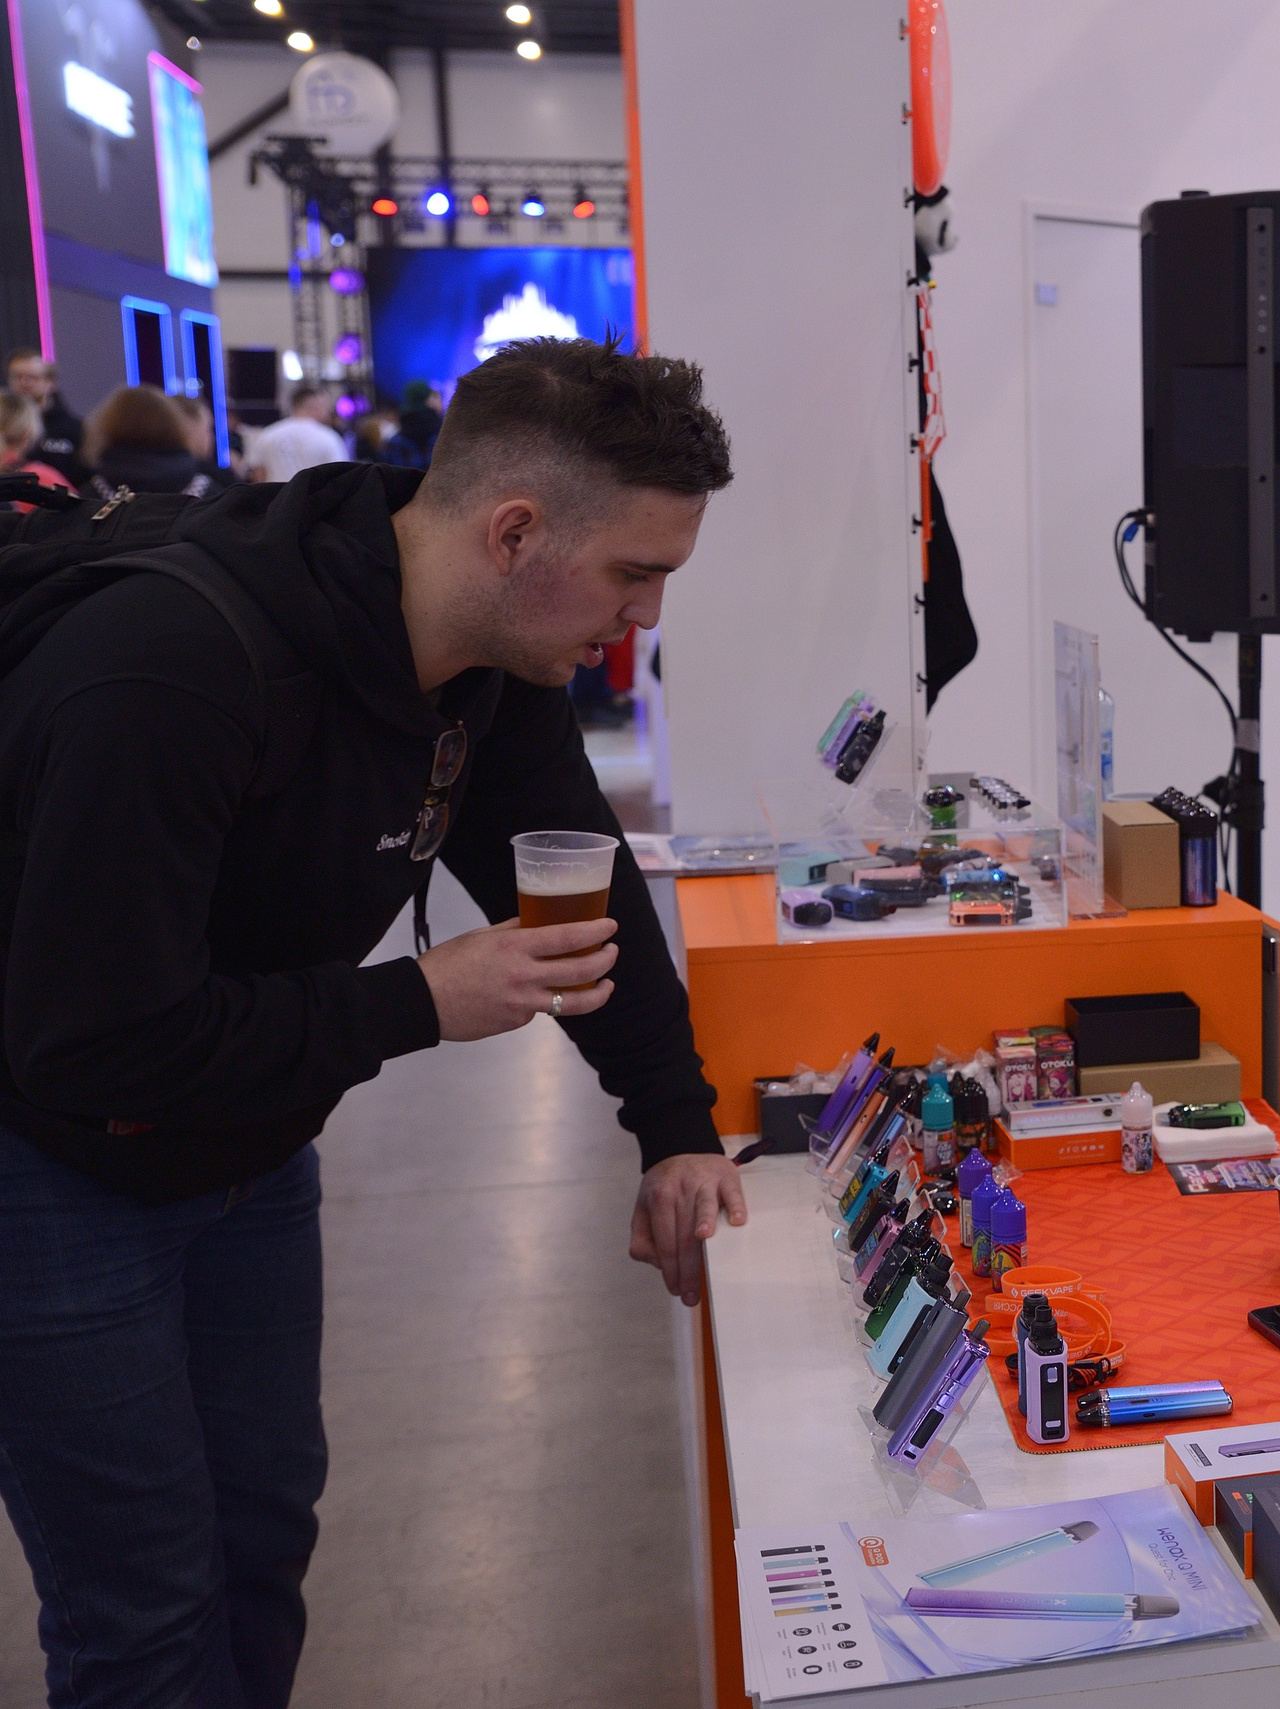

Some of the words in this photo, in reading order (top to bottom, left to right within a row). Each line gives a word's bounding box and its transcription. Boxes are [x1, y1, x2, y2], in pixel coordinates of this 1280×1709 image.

[1005, 1063, 1035, 1072] OTOKU
[1041, 1060, 1074, 1069] OTOKU
[1148, 1543, 1164, 1560] Quest
[875, 1552, 885, 1564] POD
[1158, 1559, 1169, 1568] for
[1177, 1562, 1193, 1571] Q
[1163, 1568, 1176, 1581] Chic
[1182, 1571, 1208, 1592] MINI
